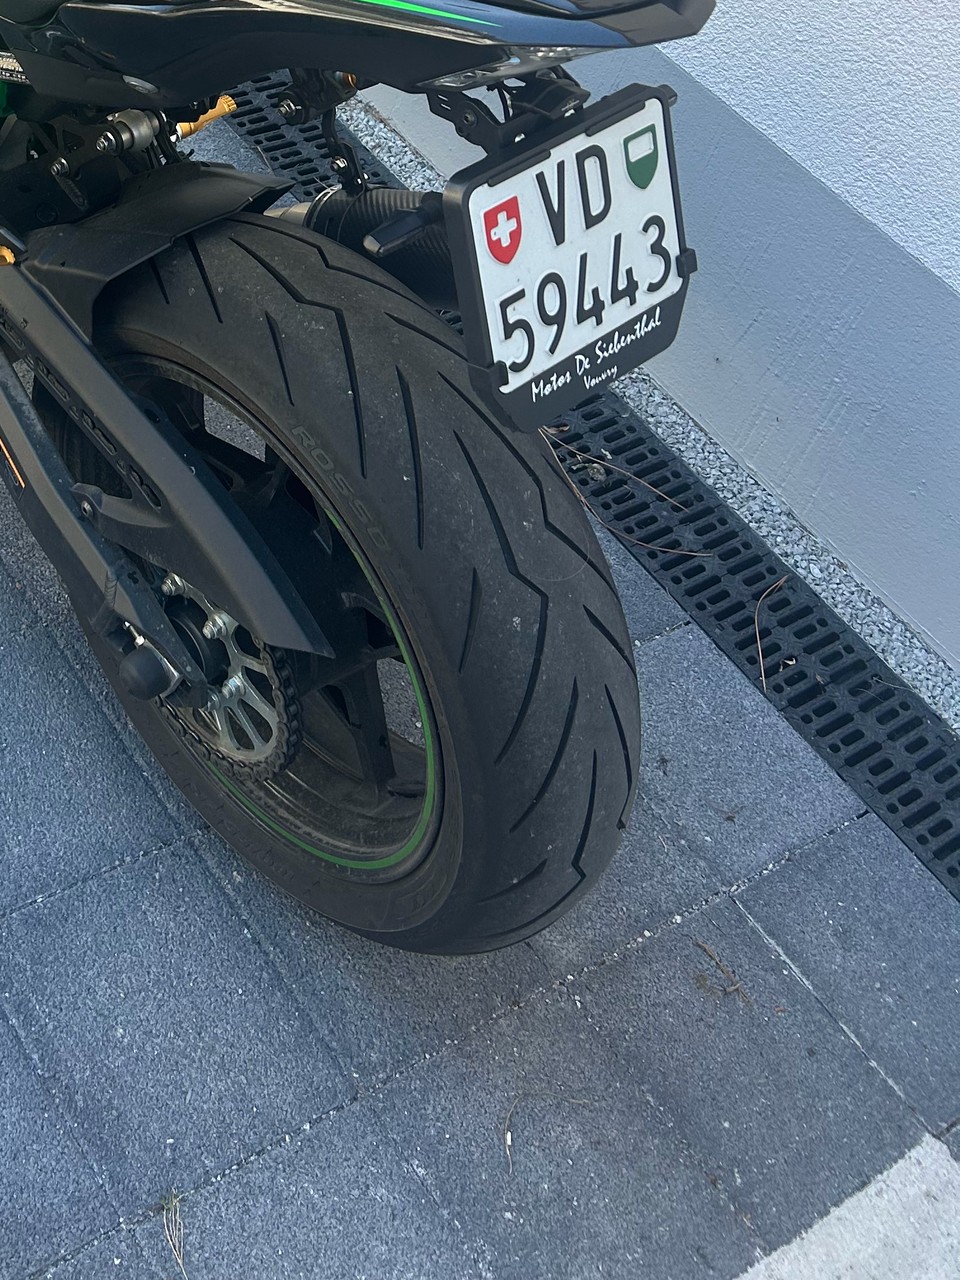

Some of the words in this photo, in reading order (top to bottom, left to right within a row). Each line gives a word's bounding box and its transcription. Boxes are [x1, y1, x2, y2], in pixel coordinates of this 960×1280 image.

[536, 144, 612, 246] VD
[500, 215, 672, 372] 59443
[531, 371, 572, 403] Motos
[574, 354, 591, 376] De
[595, 306, 662, 364] Siebenthal
[583, 365, 618, 390] Vouvry
